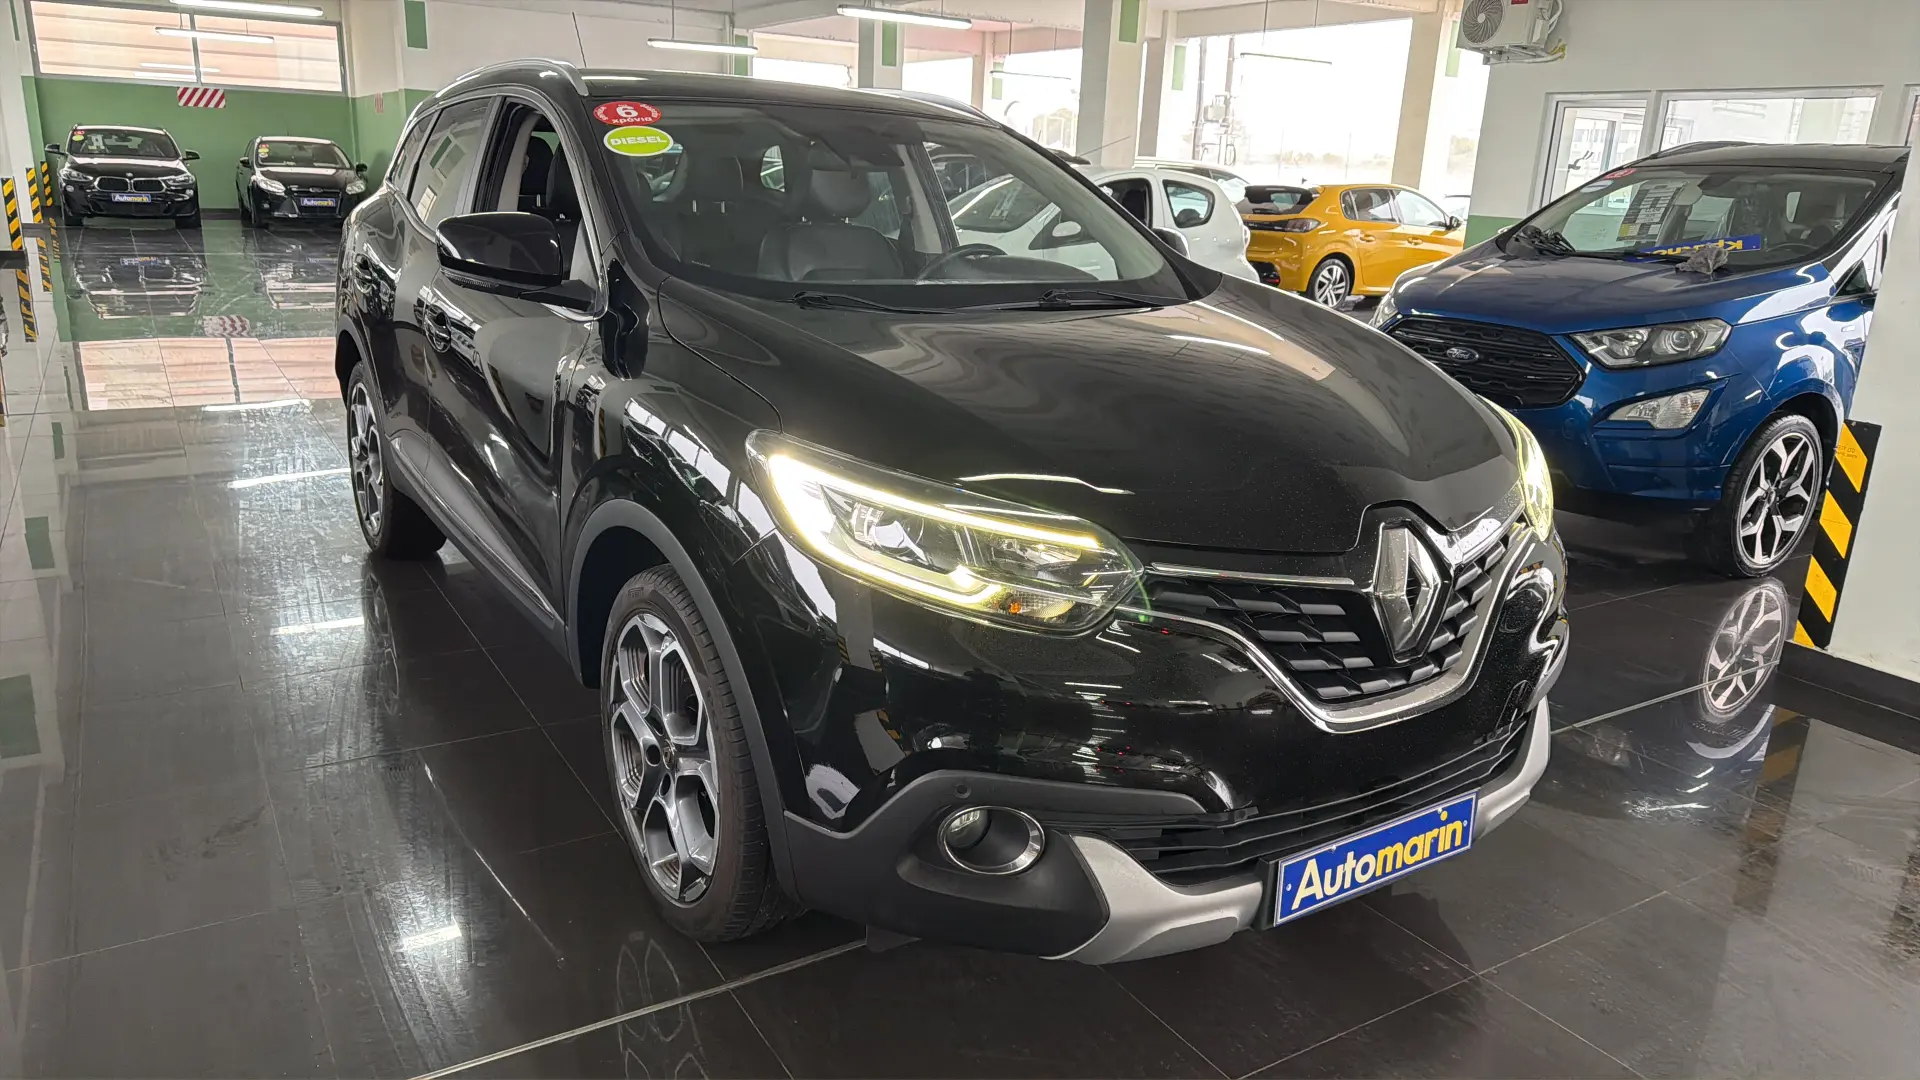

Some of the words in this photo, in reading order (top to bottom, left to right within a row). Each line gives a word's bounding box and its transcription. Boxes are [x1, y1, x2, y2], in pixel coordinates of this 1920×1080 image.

[616, 106, 638, 118] 6
[610, 136, 667, 146] DIESEL
[114, 193, 149, 202] Automarin
[303, 198, 333, 206] Automarin
[1291, 811, 1463, 910] Automarin
